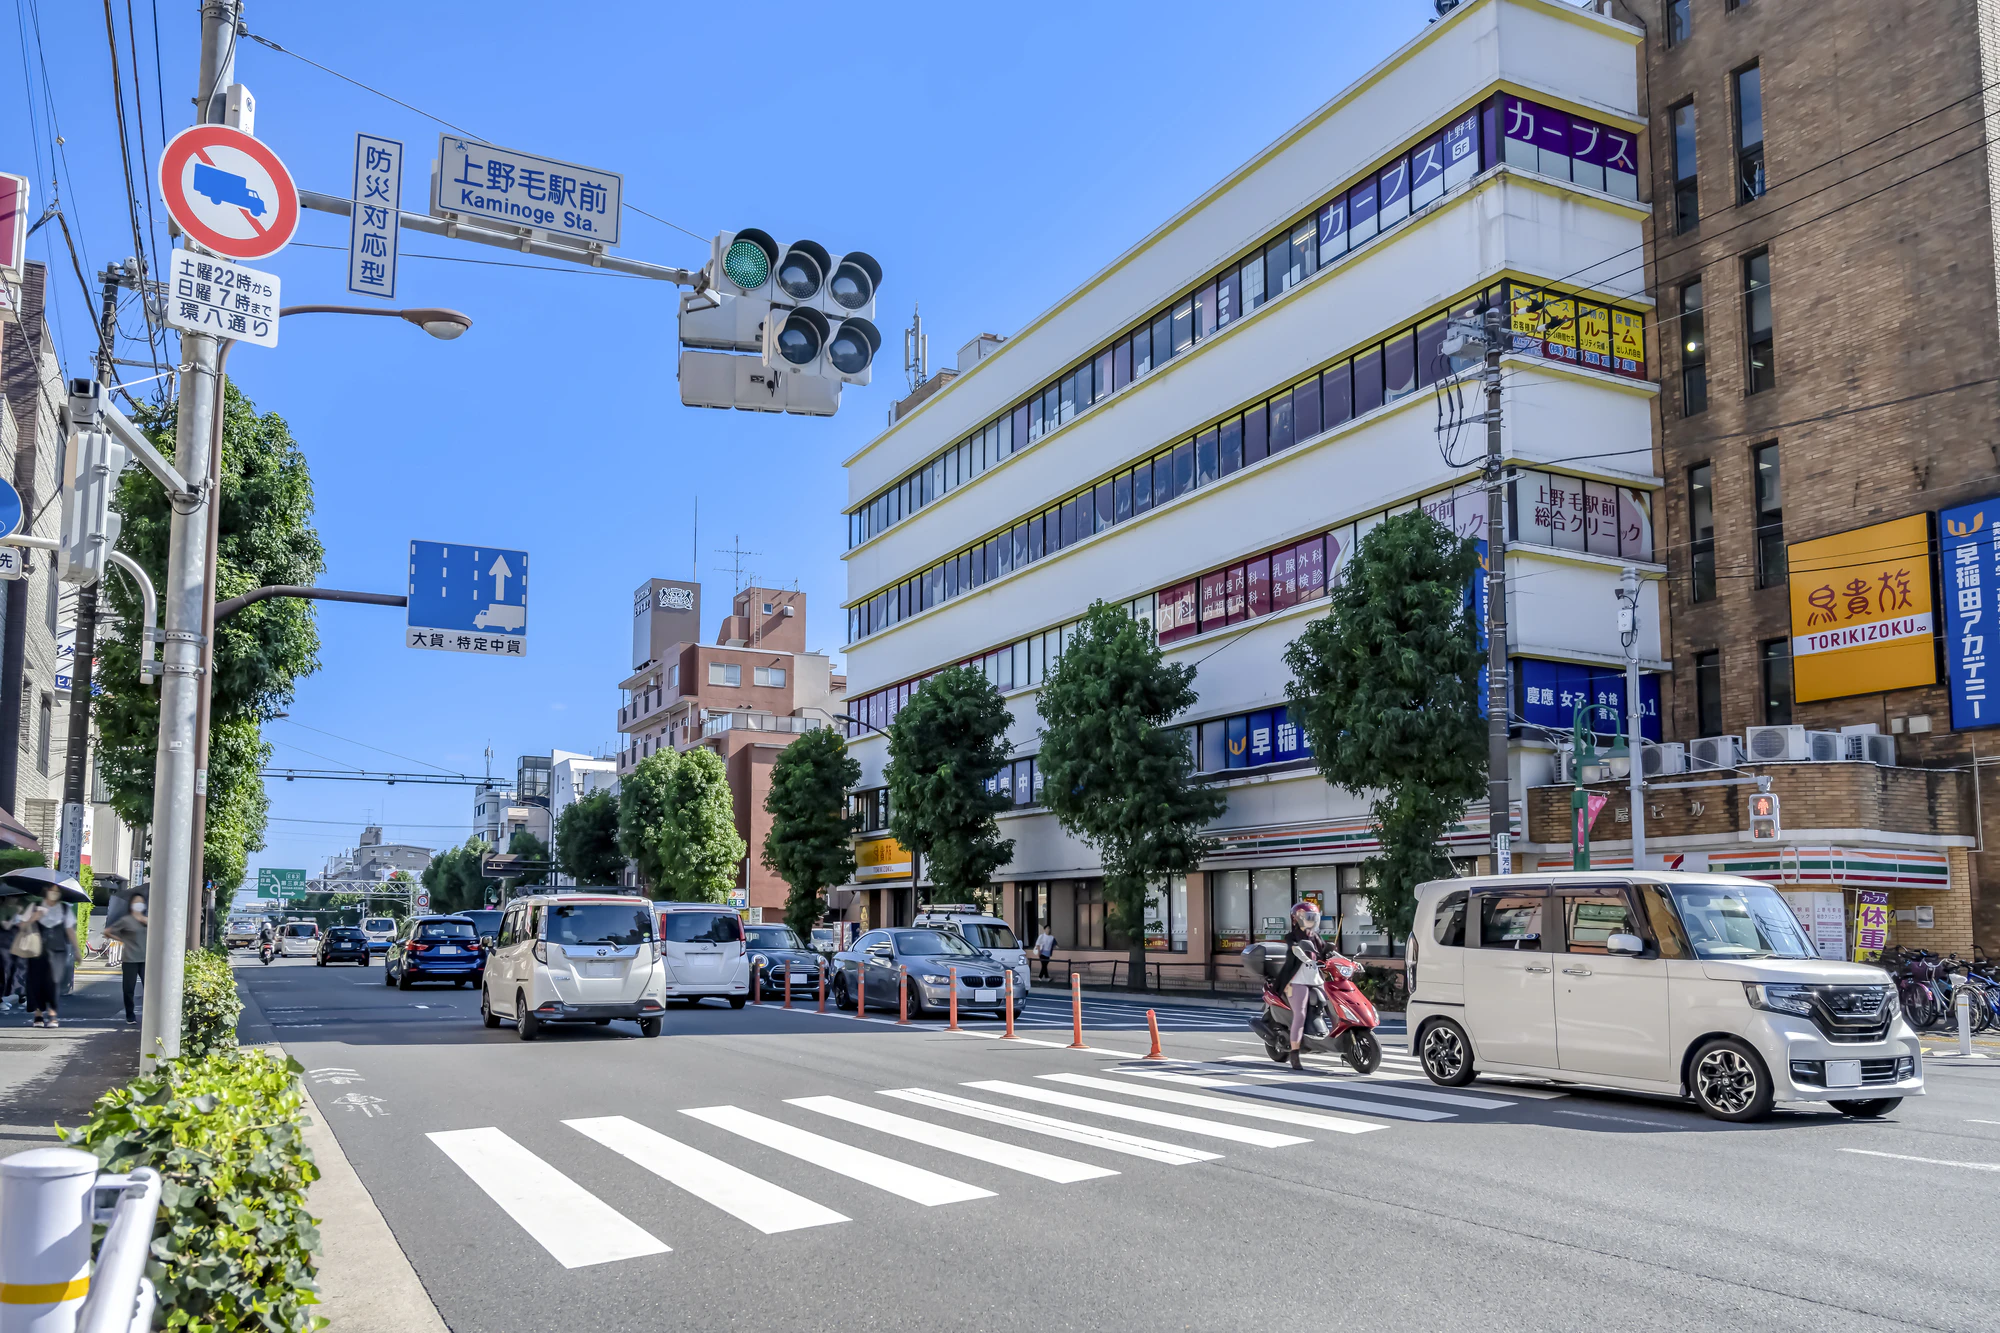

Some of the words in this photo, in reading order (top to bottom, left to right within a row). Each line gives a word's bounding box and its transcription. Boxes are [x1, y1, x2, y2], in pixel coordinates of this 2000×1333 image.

[1445, 115, 1476, 145] 上野毛
[1454, 142, 1468, 157] 5F
[1507, 100, 1635, 171] カーブス
[454, 154, 608, 215] 上野毛駅前
[1321, 143, 1442, 243] カーブス
[360, 146, 392, 286] 防災対応型
[461, 189, 554, 224] Kaminoge
[564, 211, 598, 233] Sta.
[179, 259, 273, 298] 土曜22時から
[179, 301, 269, 338] 環八通り
[1513, 301, 1636, 346] トラクルーム
[1535, 485, 1616, 518] 上野毛駅前
[1534, 506, 1640, 542] 総合クリニック
[1160, 591, 1194, 630] 内科
[1807, 568, 1913, 626] 鳥貴族
[412, 632, 521, 654] 大貨・特定中貨
[1808, 619, 1914, 650] TORIKIZOKU
[1955, 542, 1986, 718] 早稲田アカデミー
[1598, 691, 1618, 706] 合格
[1252, 722, 1310, 756] 早稲
[1859, 906, 1887, 949] 体重
